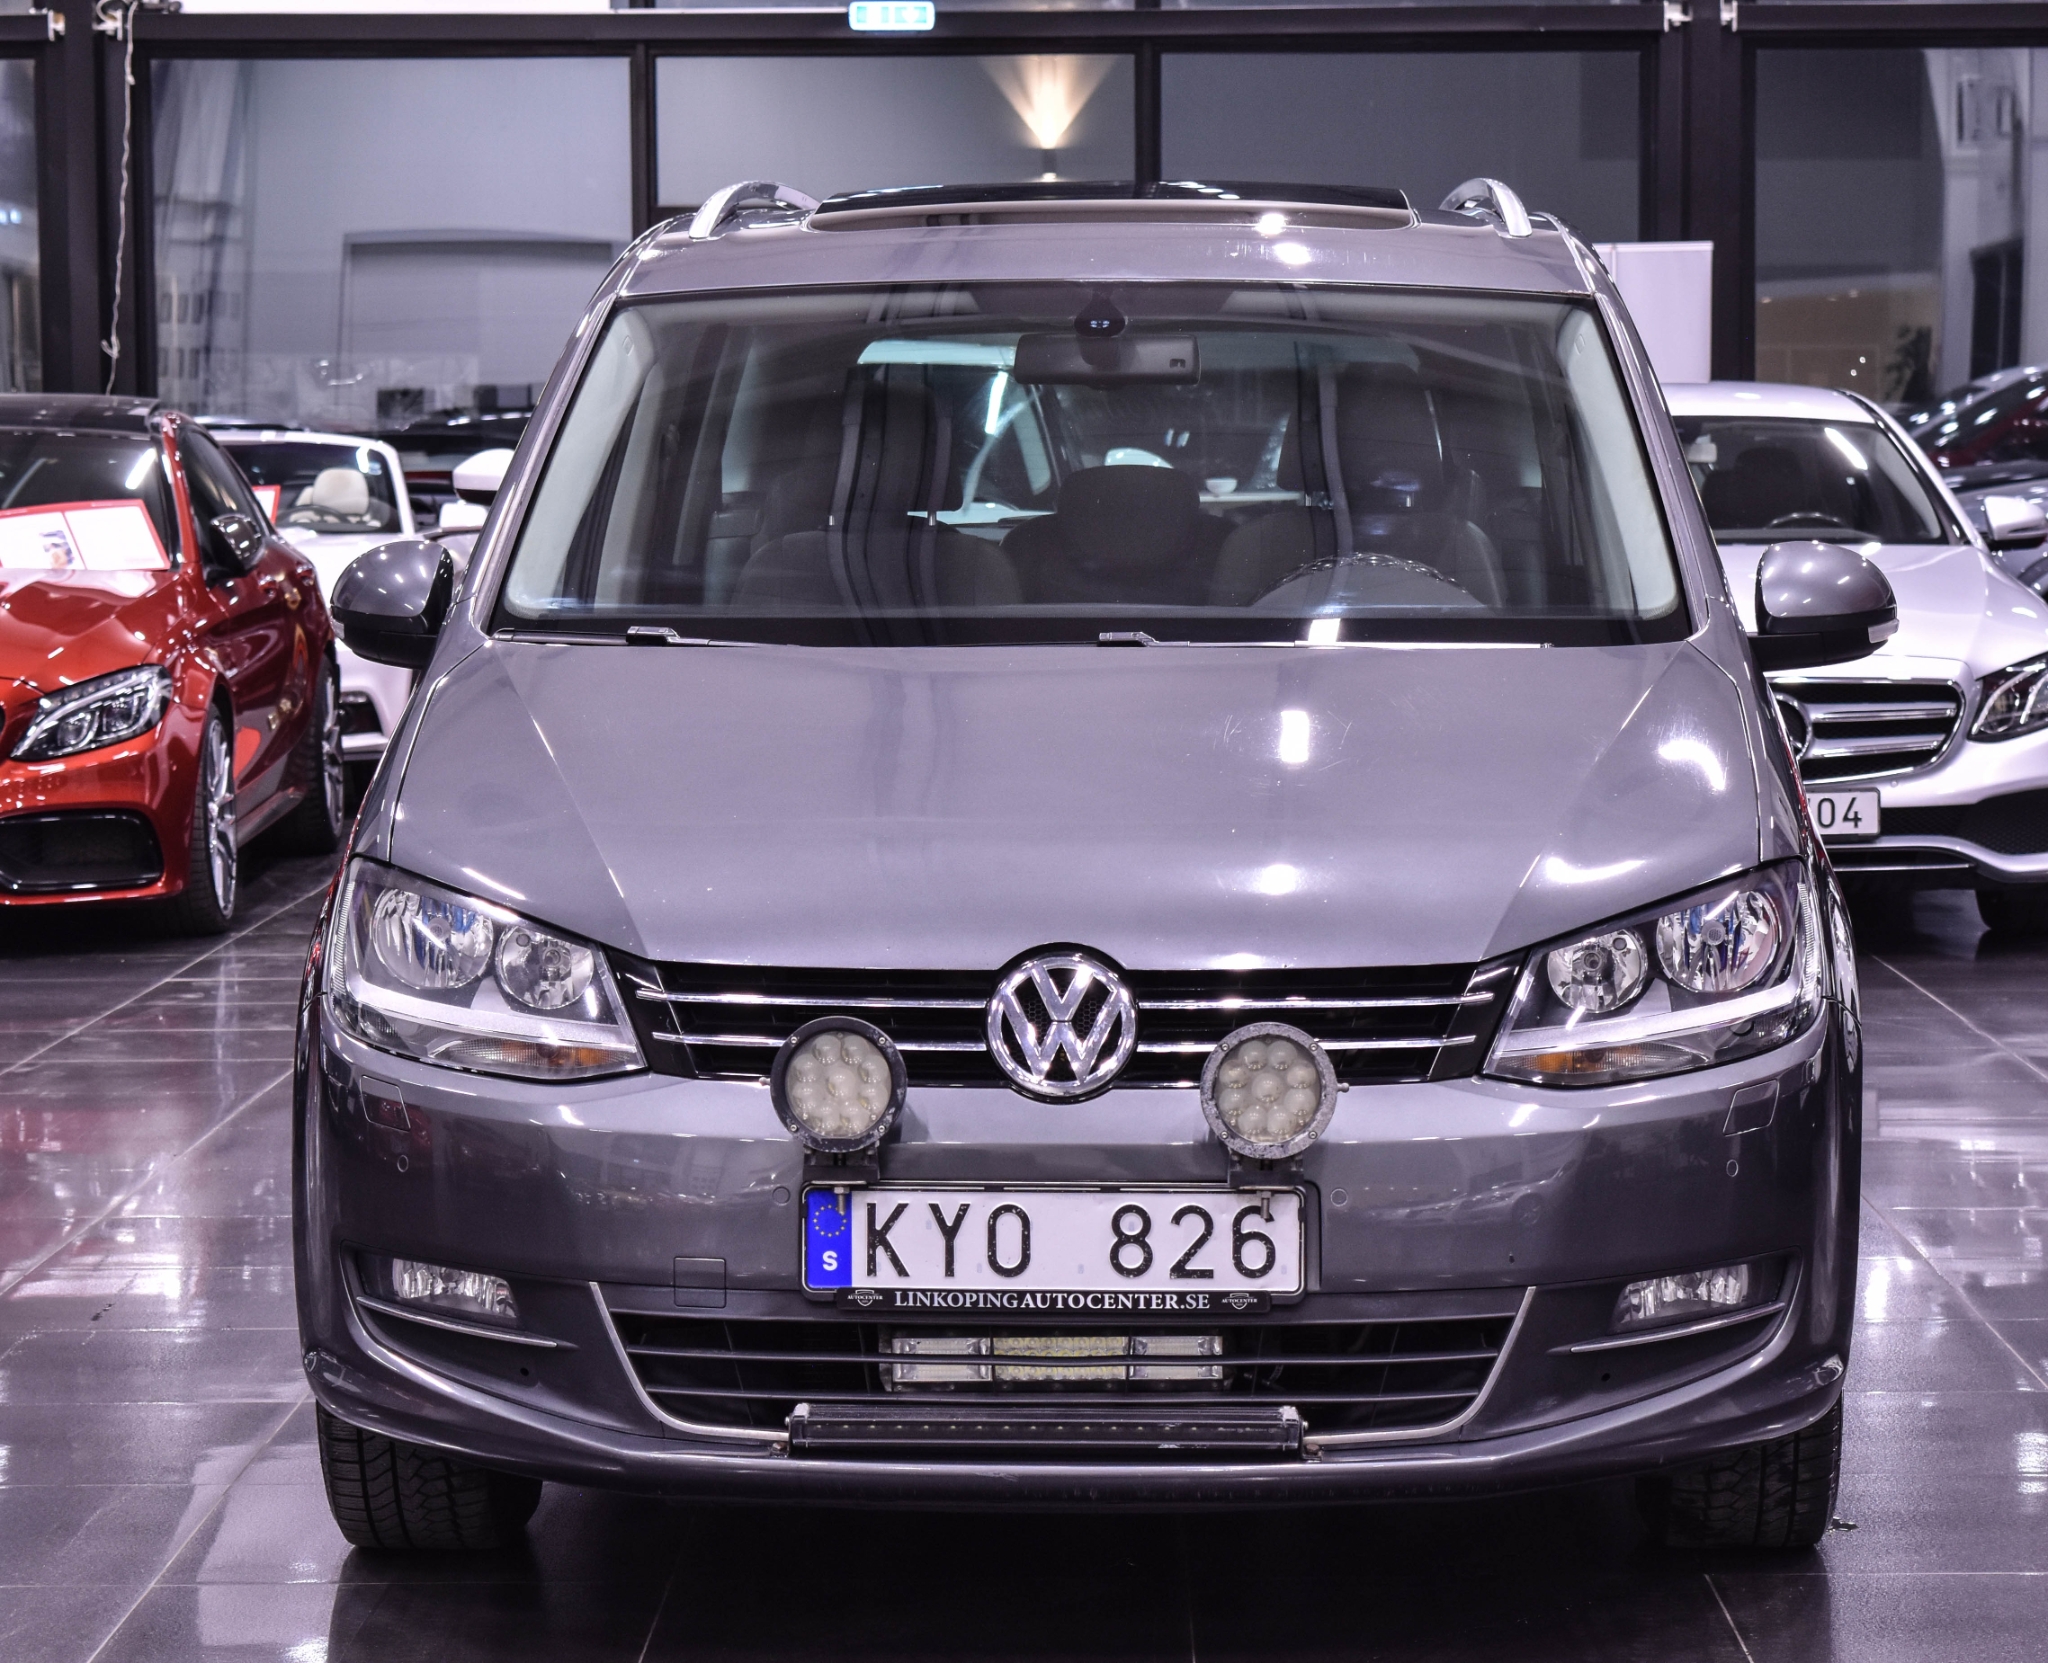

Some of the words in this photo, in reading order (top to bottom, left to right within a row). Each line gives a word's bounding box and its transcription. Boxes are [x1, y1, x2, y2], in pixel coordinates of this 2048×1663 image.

[1808, 797, 1862, 829] 04
[866, 1202, 1032, 1278] KYO
[1109, 1203, 1277, 1279] 826
[822, 1250, 838, 1272] S
